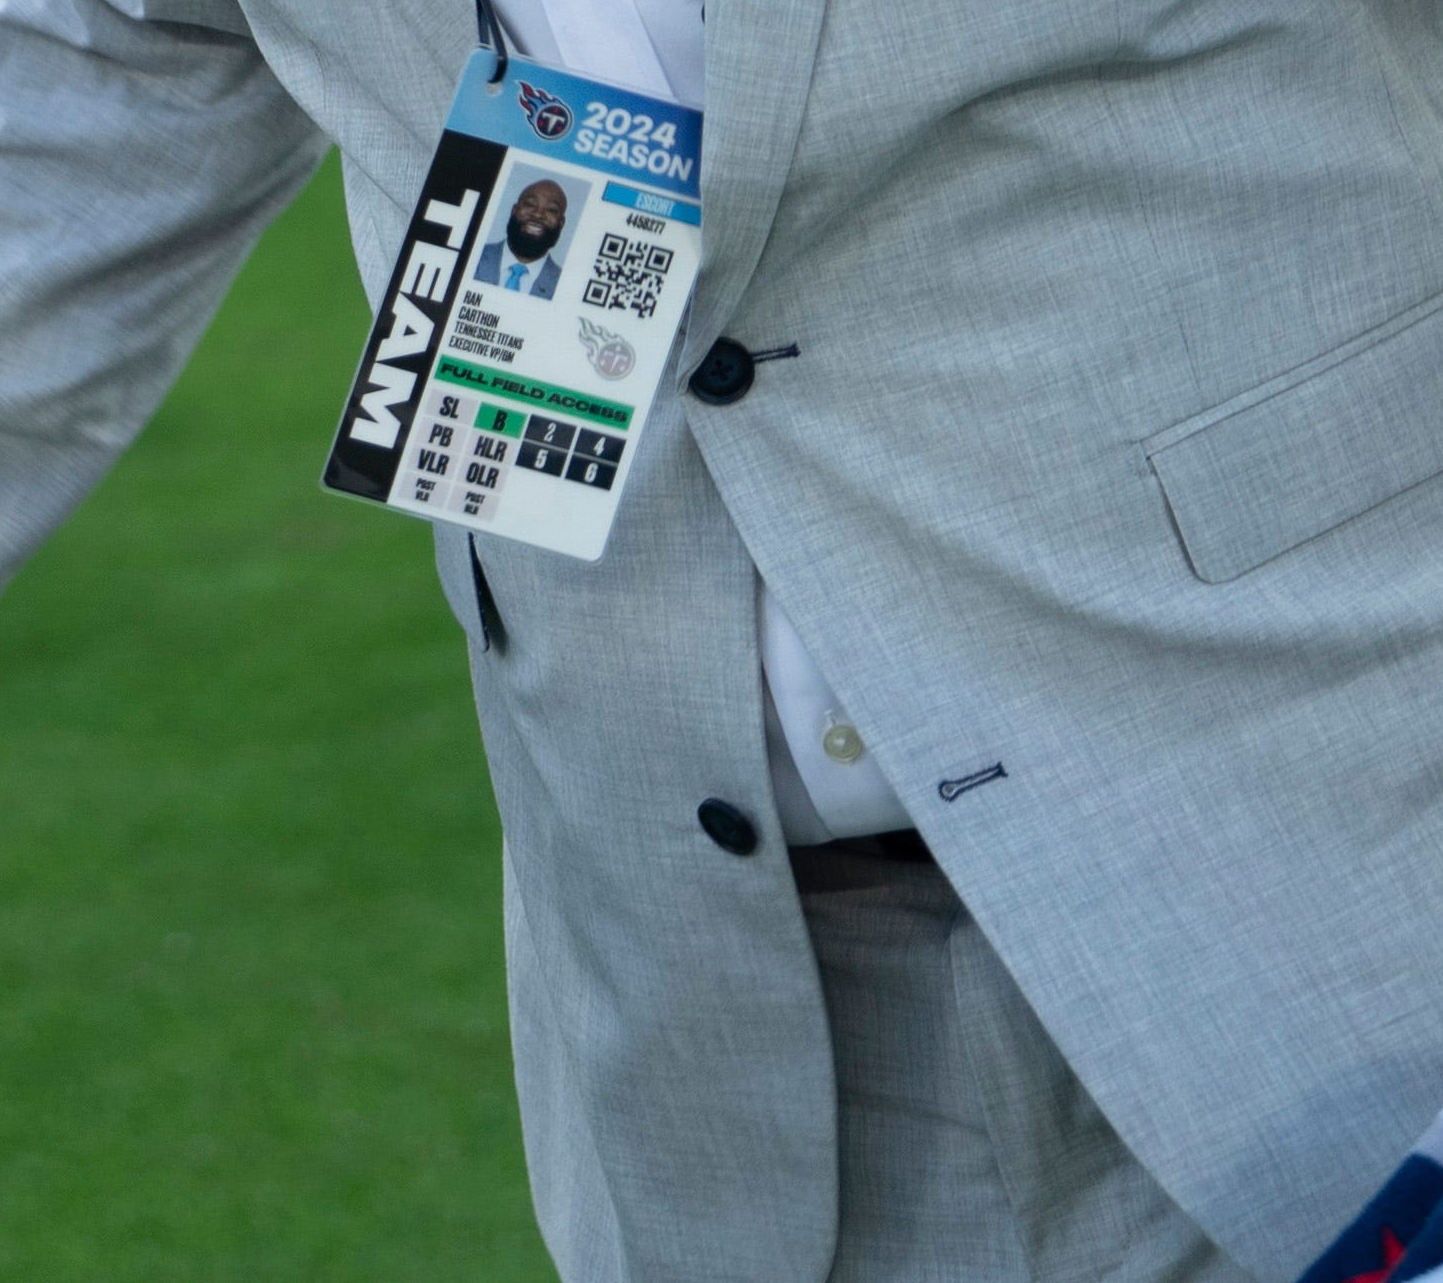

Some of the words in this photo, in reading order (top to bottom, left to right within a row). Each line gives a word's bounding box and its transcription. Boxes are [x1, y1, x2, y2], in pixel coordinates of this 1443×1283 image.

[582, 101, 677, 149] 2024
[573, 129, 693, 181] SEASON
[463, 290, 483, 307] RAN
[349, 188, 480, 449] TEAM
[458, 306, 500, 328] CARTHON
[448, 335, 490, 357] EXECUTIVE
[454, 321, 497, 343] TENNESSEE
[497, 332, 524, 350] TITANS
[440, 363, 488, 384] FULL
[491, 377, 545, 400] FIELD
[546, 393, 628, 423] ACCESS
[439, 395, 460, 419] SL
[492, 409, 508, 431] B
[428, 423, 454, 447] PB
[543, 422, 557, 443] 2
[474, 435, 508, 463] HLR
[593, 436, 607, 456] 4
[417, 449, 450, 475] VLR
[534, 449, 549, 469] 5
[466, 462, 500, 489] OLR
